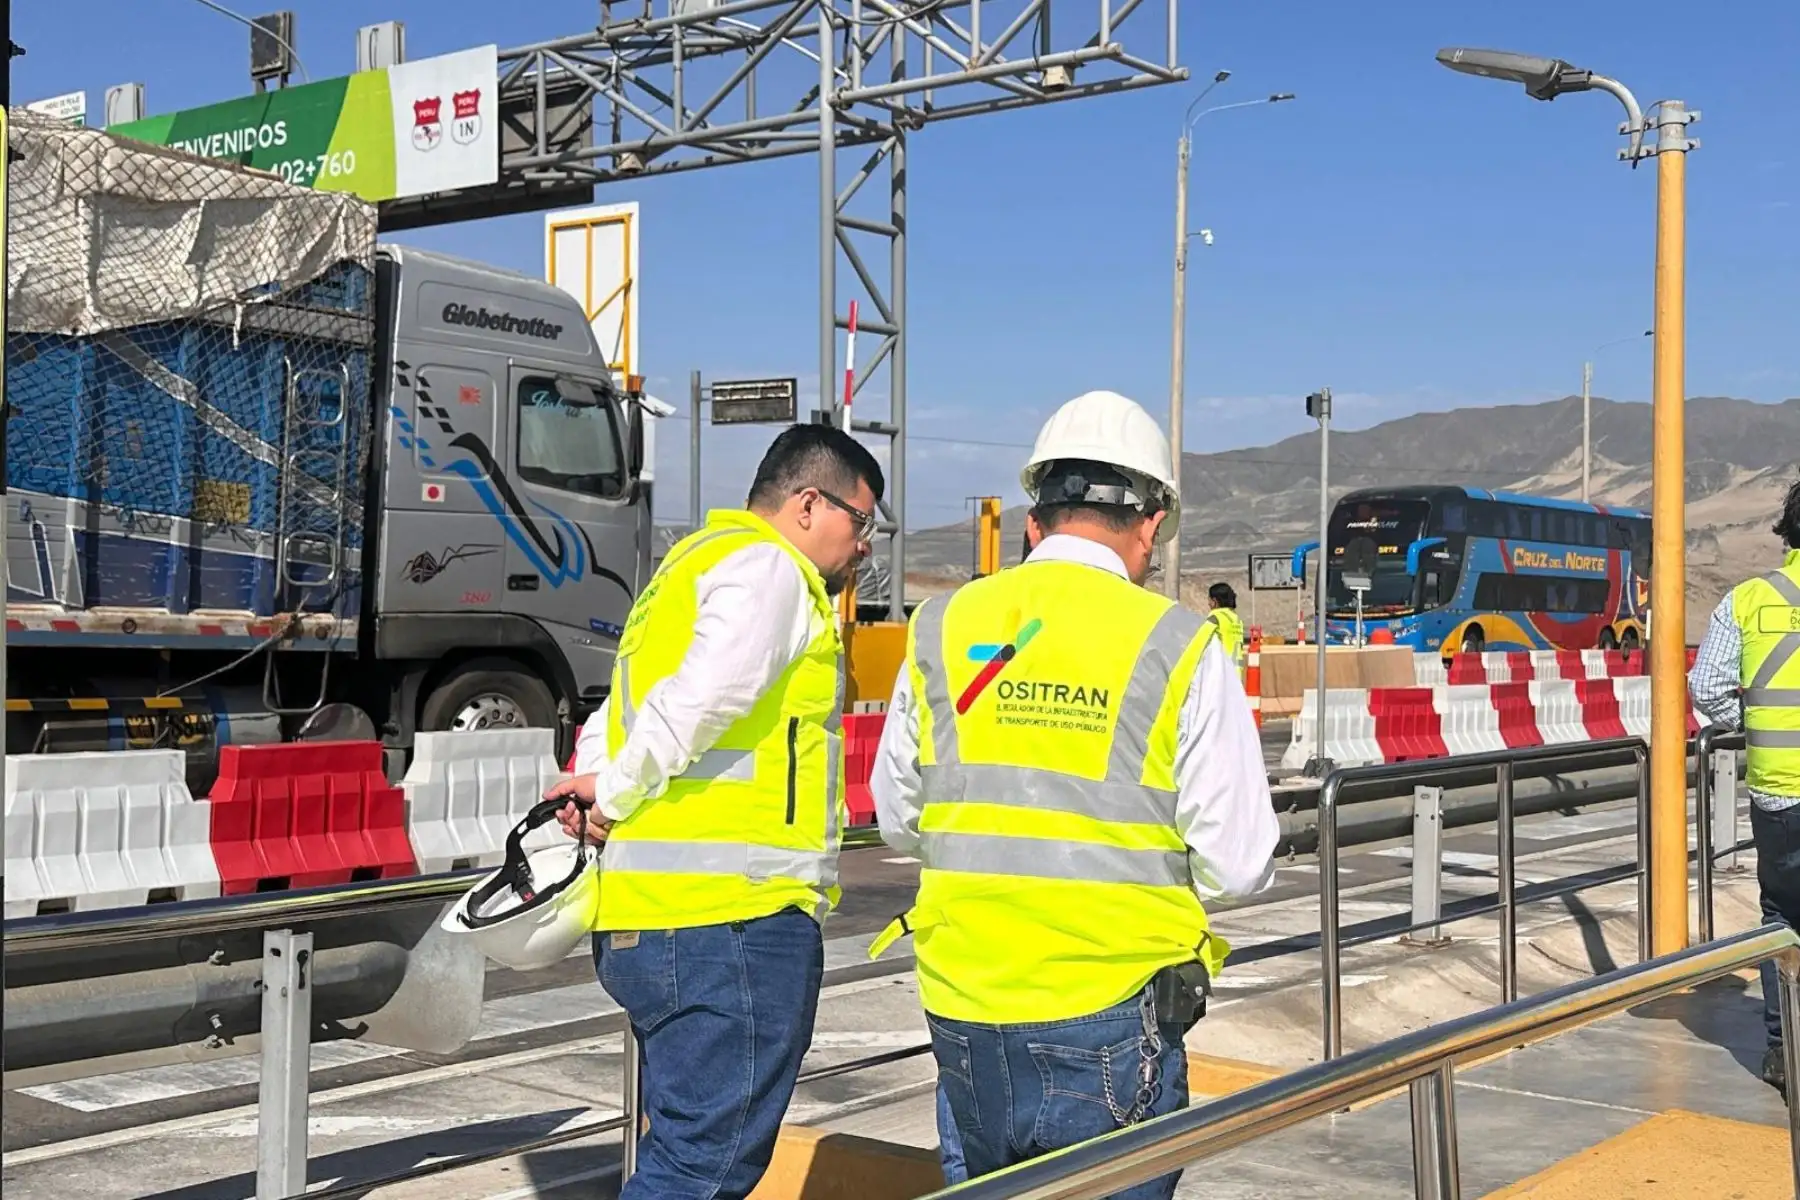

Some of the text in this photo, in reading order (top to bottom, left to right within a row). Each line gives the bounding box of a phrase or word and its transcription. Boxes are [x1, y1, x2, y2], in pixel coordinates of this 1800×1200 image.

[442, 302, 564, 341] Globetrotter
[1513, 547, 1548, 568] CRUZ
[1565, 551, 1606, 572] NORTE
[997, 680, 1109, 708] OSITRAN
[996, 716, 1003, 725] DE
[1004, 716, 1049, 728] TRANSPORTE
[1049, 719, 1060, 729] DE
[1060, 721, 1075, 730] USO
[1002, 703, 1035, 713] REGULADOR
[1036, 705, 1045, 714] DE
[1045, 706, 1053, 714] LA
[1053, 707, 1108, 721] INFRAESTRUCTURA
